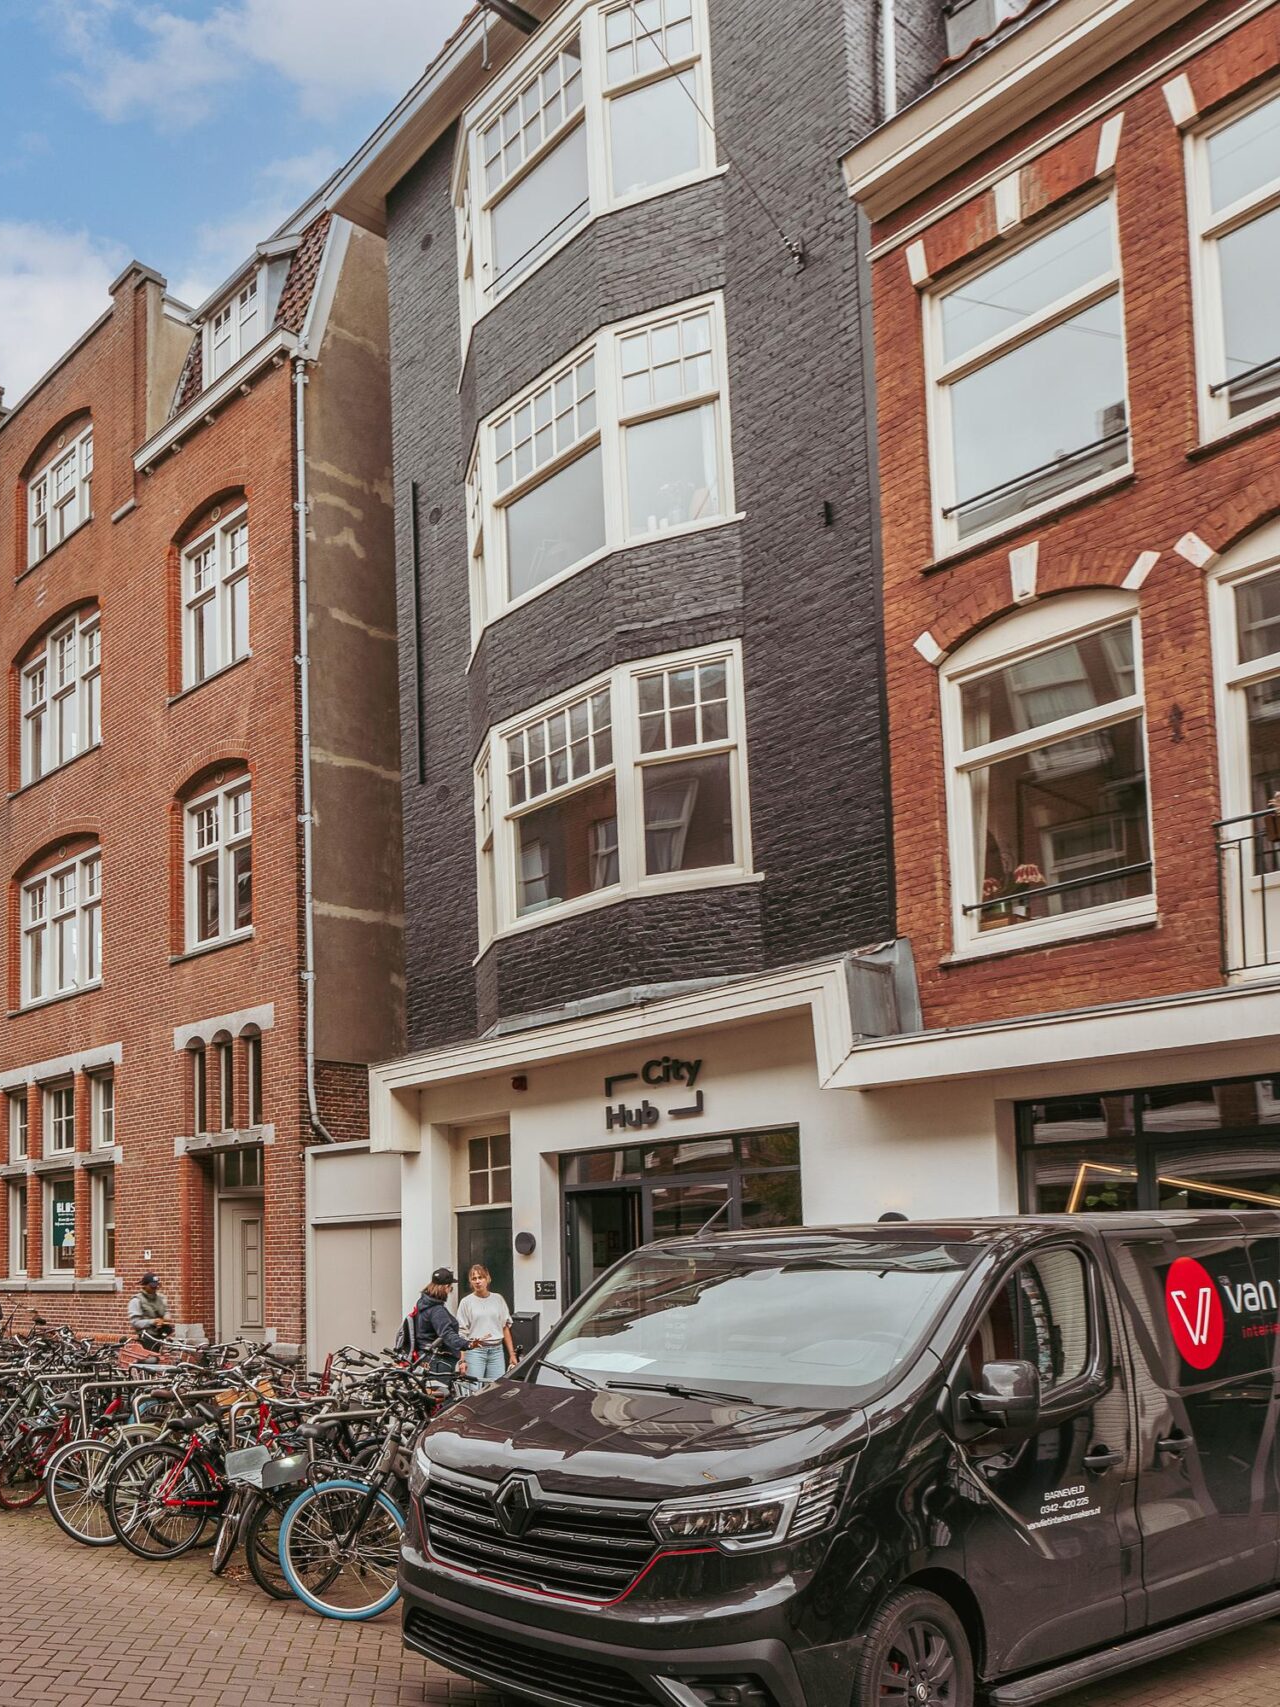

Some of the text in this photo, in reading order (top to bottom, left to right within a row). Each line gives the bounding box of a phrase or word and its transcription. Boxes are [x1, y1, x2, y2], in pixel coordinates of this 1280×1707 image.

[641, 1056, 702, 1087] City
[606, 1100, 659, 1130] Hub
[536, 1283, 542, 1293] 3
[1223, 1280, 1278, 1314] van
[1044, 1485, 1085, 1500] BARNEVELD
